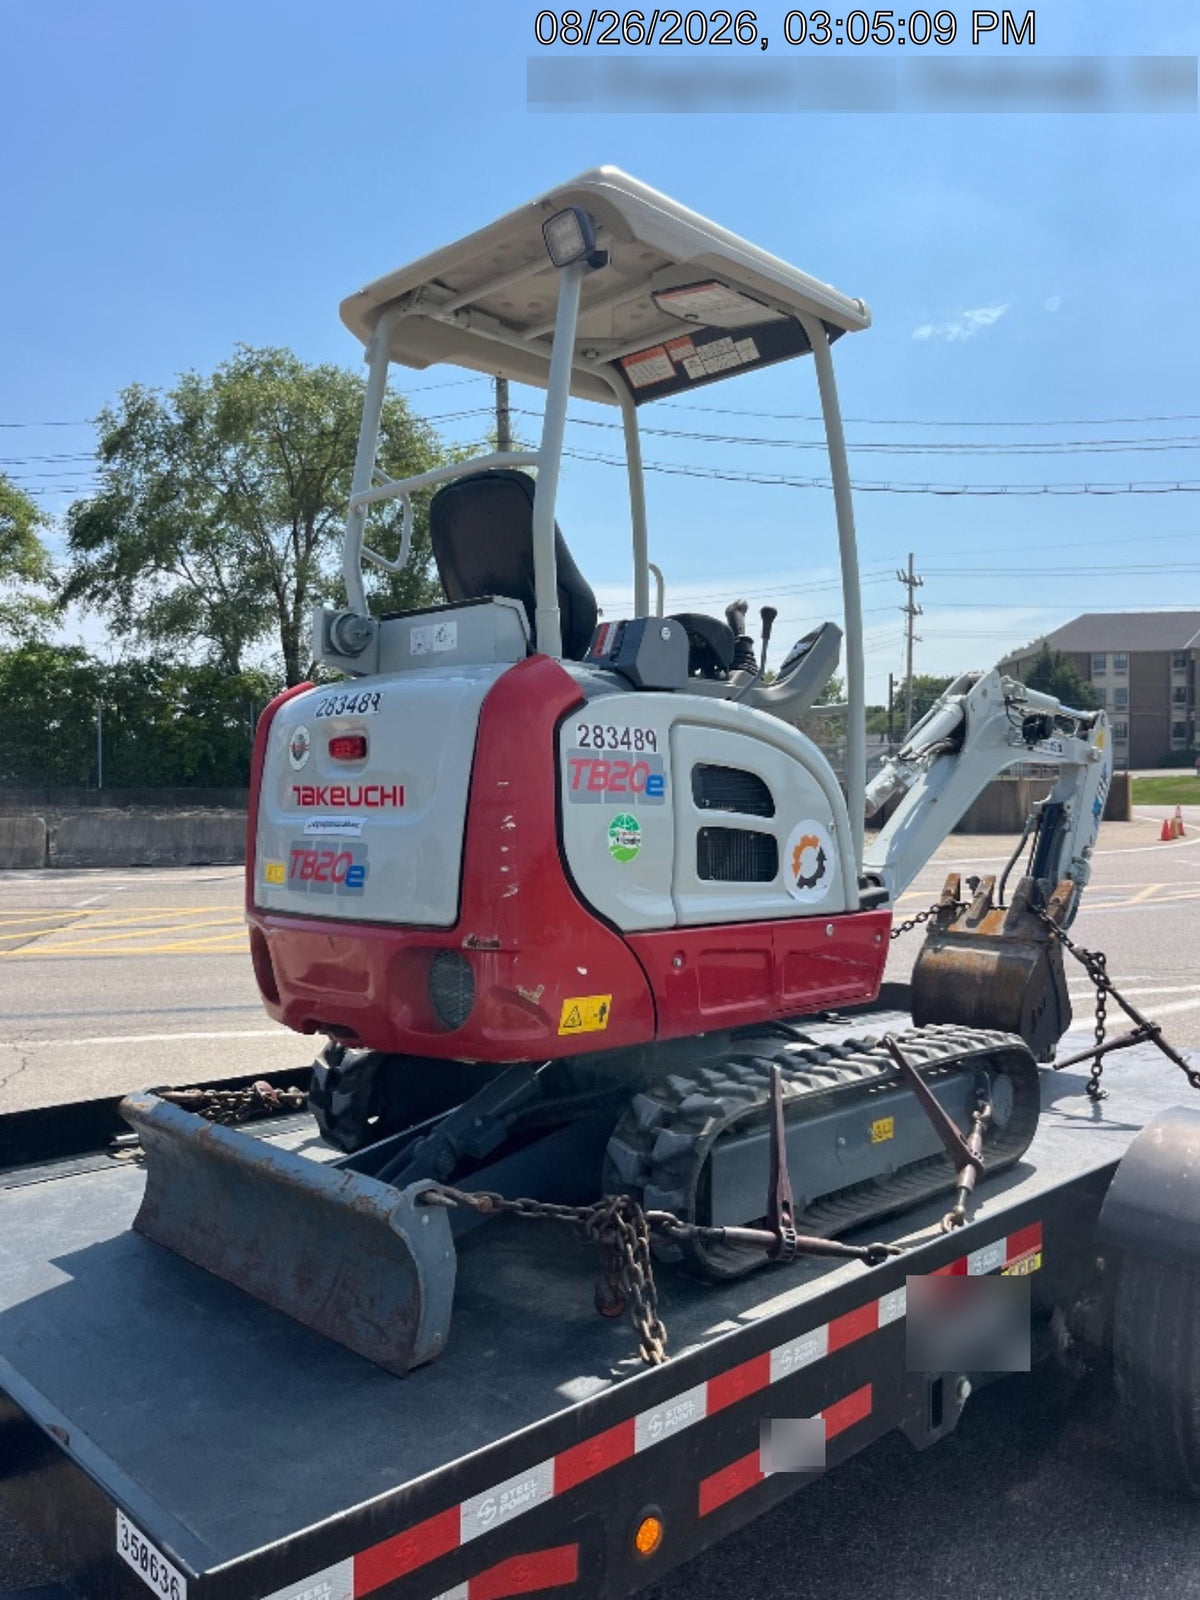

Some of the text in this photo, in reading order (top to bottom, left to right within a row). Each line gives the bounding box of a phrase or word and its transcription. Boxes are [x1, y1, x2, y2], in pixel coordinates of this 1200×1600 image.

[315, 692, 382, 718] 283489
[577, 724, 657, 753] 283489
[500, 1479, 538, 1502] STEEL
[500, 1489, 537, 1515] POINT
